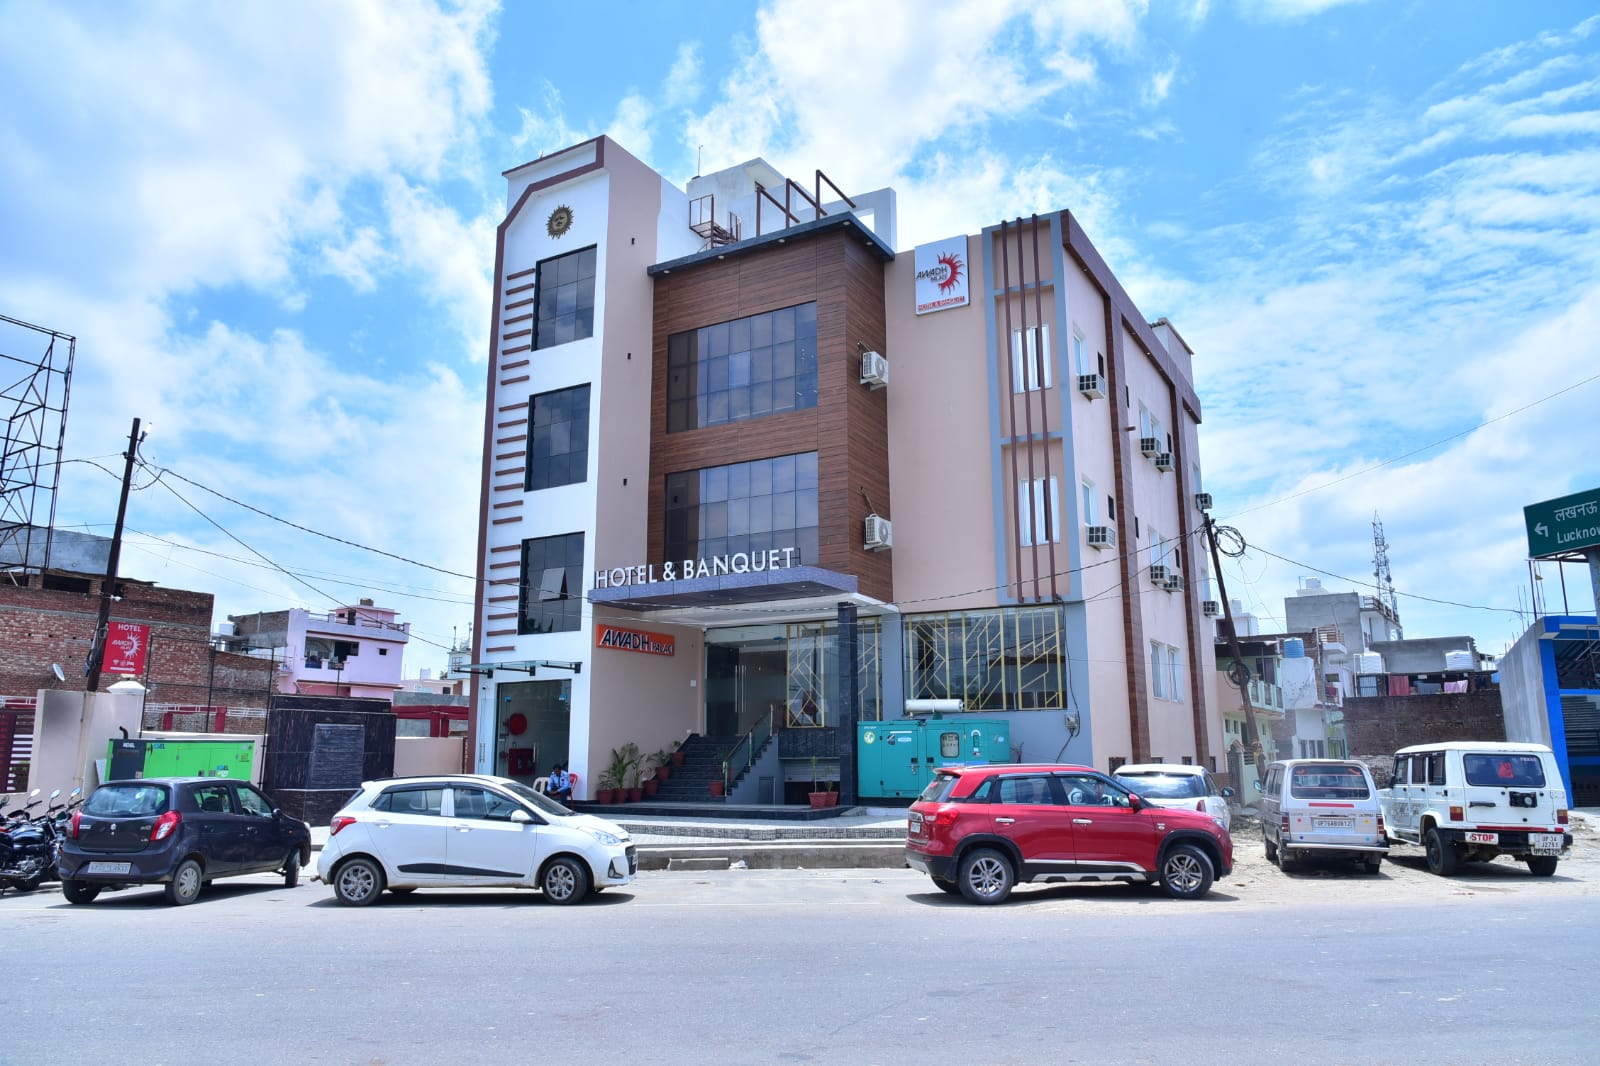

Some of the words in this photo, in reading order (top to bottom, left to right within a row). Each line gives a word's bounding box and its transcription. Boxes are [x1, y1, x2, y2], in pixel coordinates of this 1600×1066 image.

[916, 266, 947, 279] AWADH
[1553, 501, 1597, 521] लखनऊ
[595, 564, 657, 589] HOTEL
[662, 561, 676, 581] &
[683, 547, 794, 579] BANQUET
[118, 624, 141, 632] HOTEL
[600, 629, 649, 651] AWADH
[1471, 833, 1495, 842] STOP
